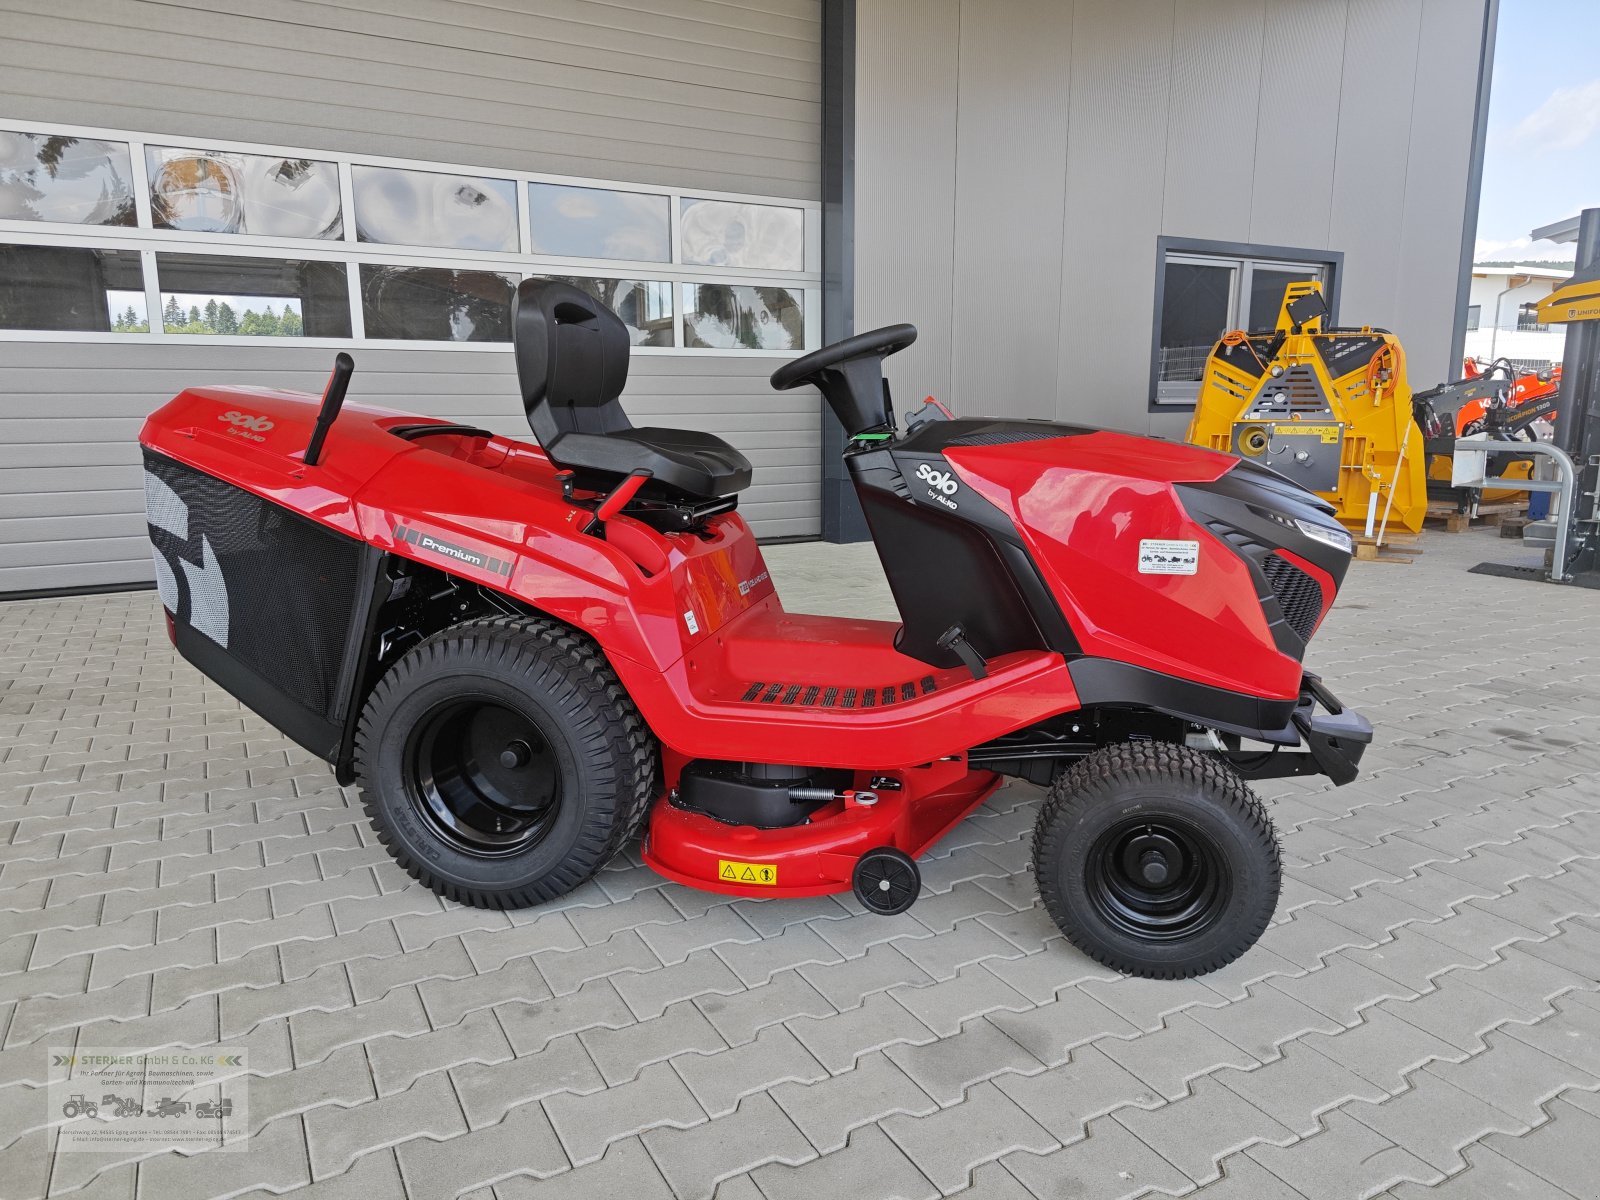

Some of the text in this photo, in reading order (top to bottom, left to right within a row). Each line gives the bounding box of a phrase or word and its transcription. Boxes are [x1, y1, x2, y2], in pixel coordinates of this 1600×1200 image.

[927, 489, 938, 500] by
[422, 537, 481, 565] Premium
[394, 806, 441, 861] CARLSTAR
